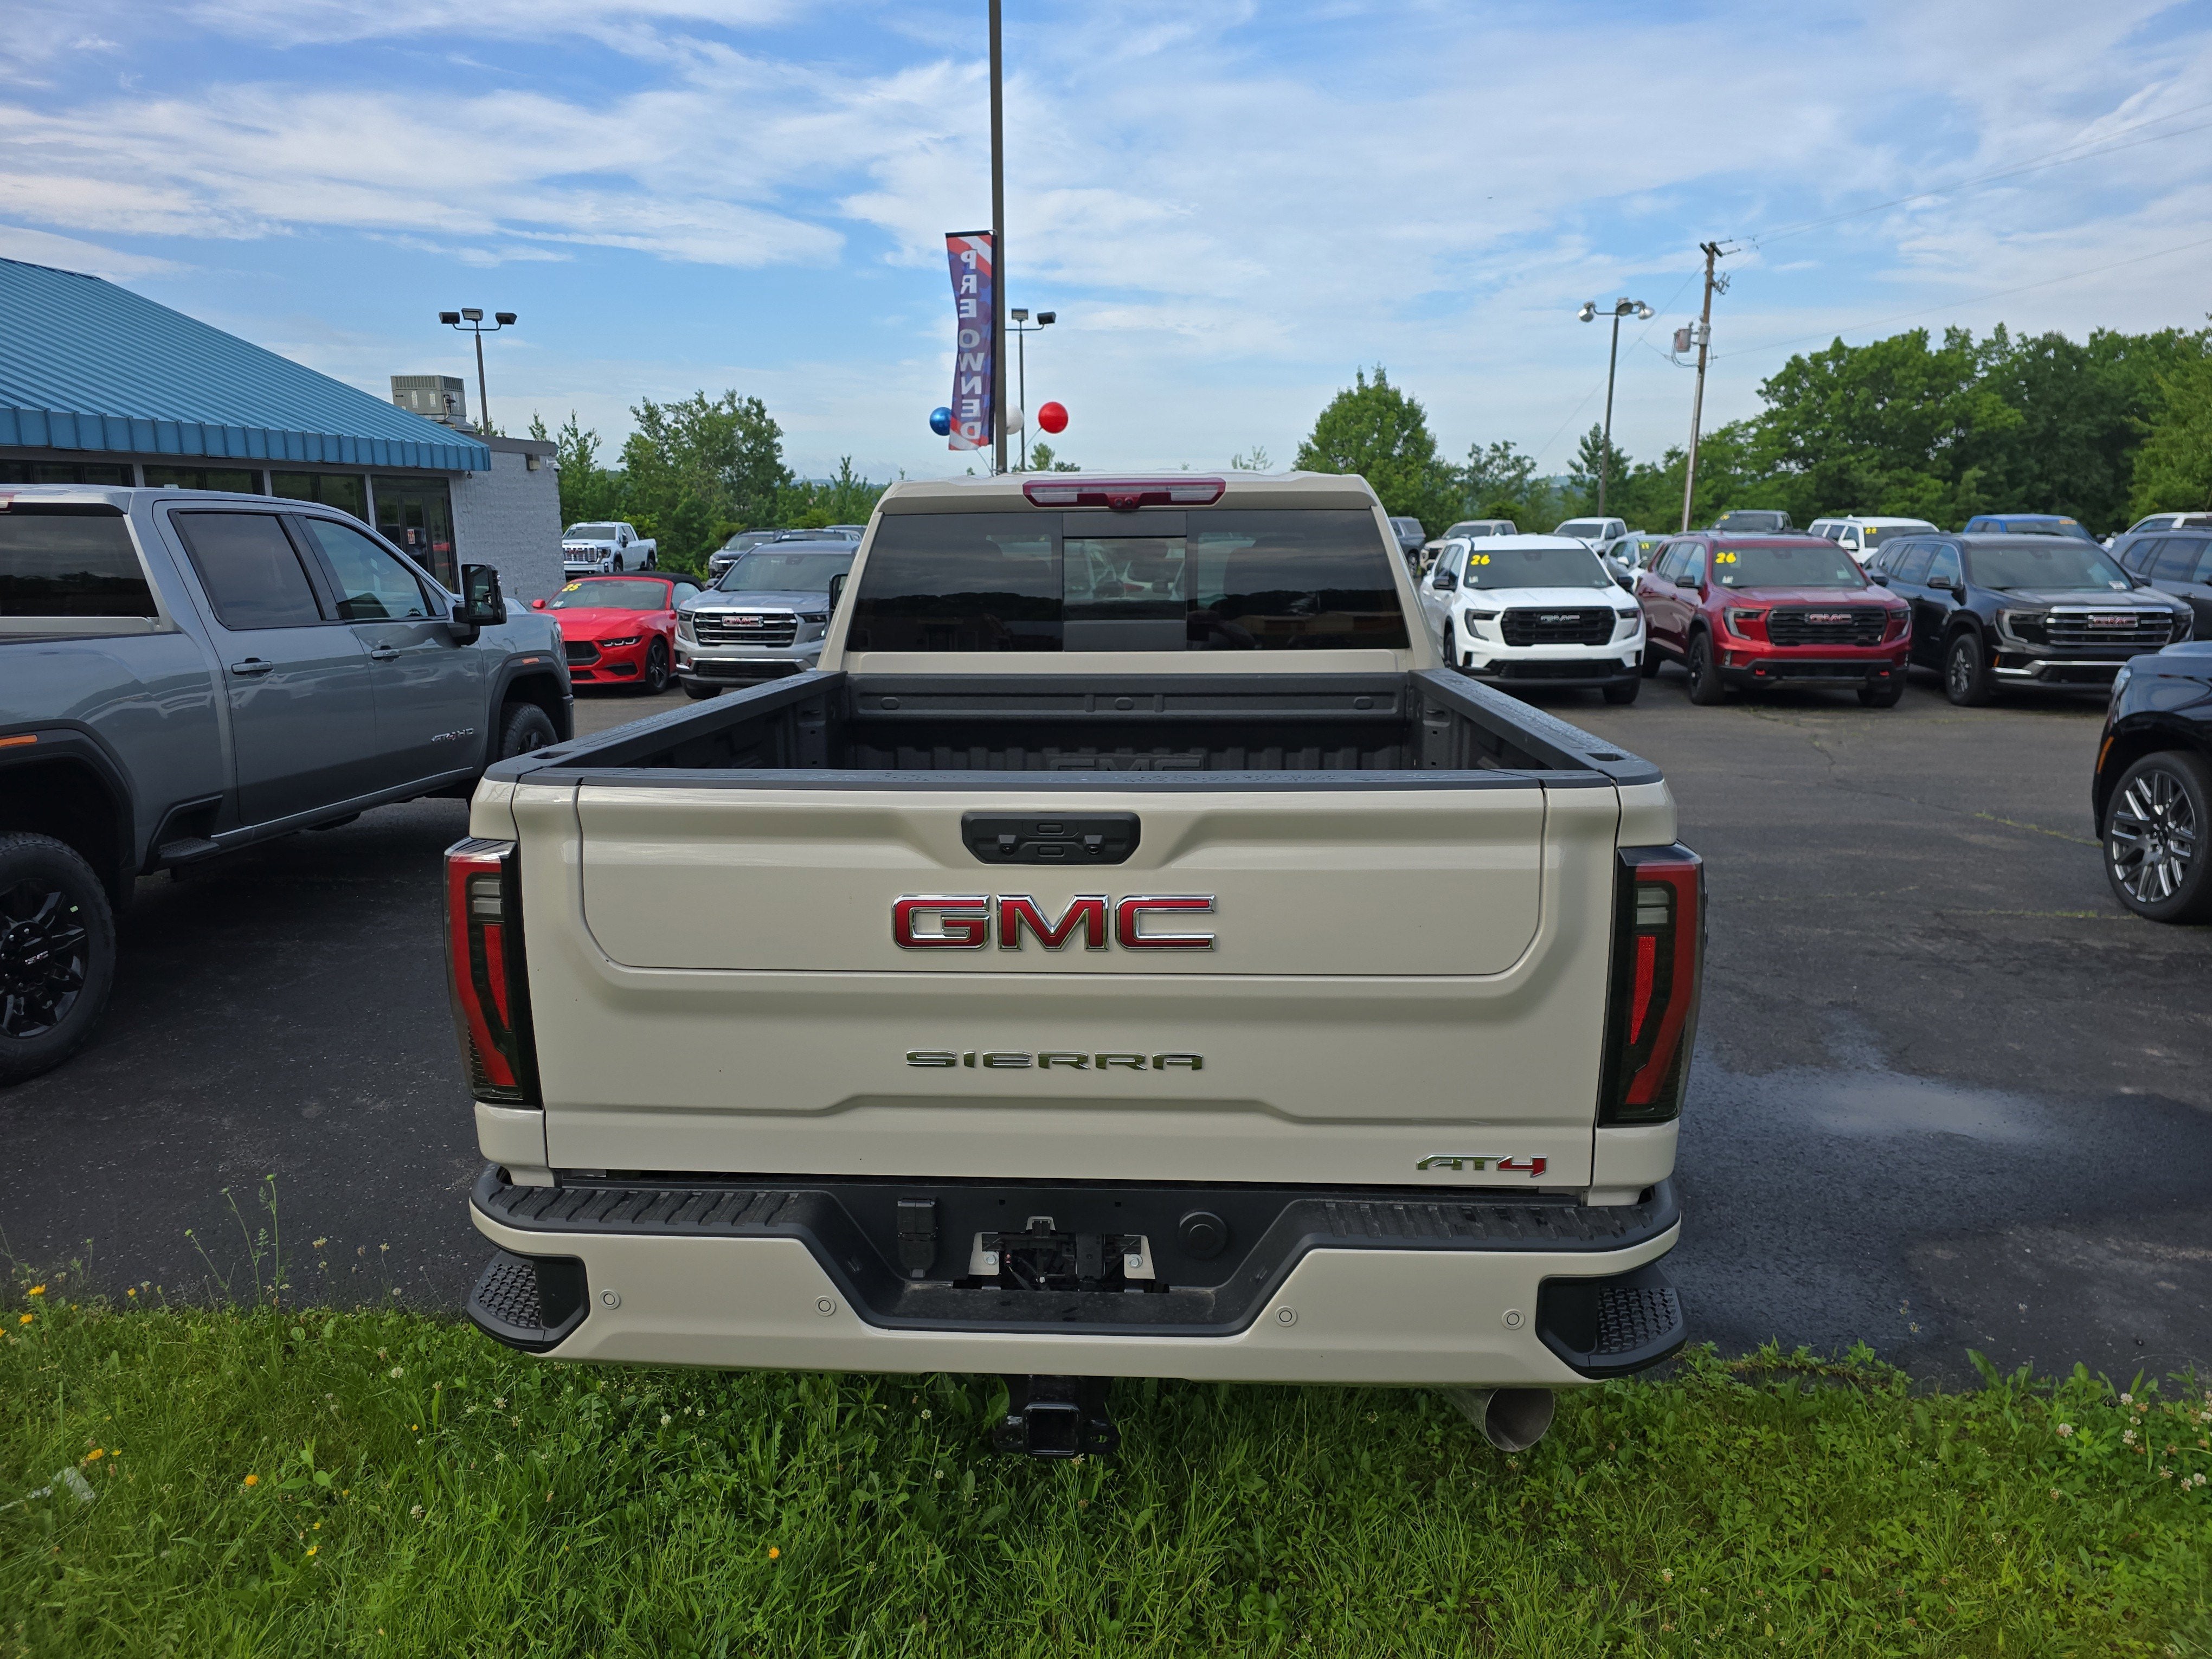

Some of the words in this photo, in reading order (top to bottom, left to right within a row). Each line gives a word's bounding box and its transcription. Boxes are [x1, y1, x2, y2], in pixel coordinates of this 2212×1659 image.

[1470, 554, 1490, 565] 26
[1715, 551, 1737, 564] 26
[723, 617, 760, 626] GMC
[1809, 614, 1852, 624] GMC
[2092, 616, 2138, 626] GMC
[891, 893, 1216, 951] GMC
[906, 1050, 1204, 1071] SIERRA
[1416, 1154, 1548, 1178] AT4
